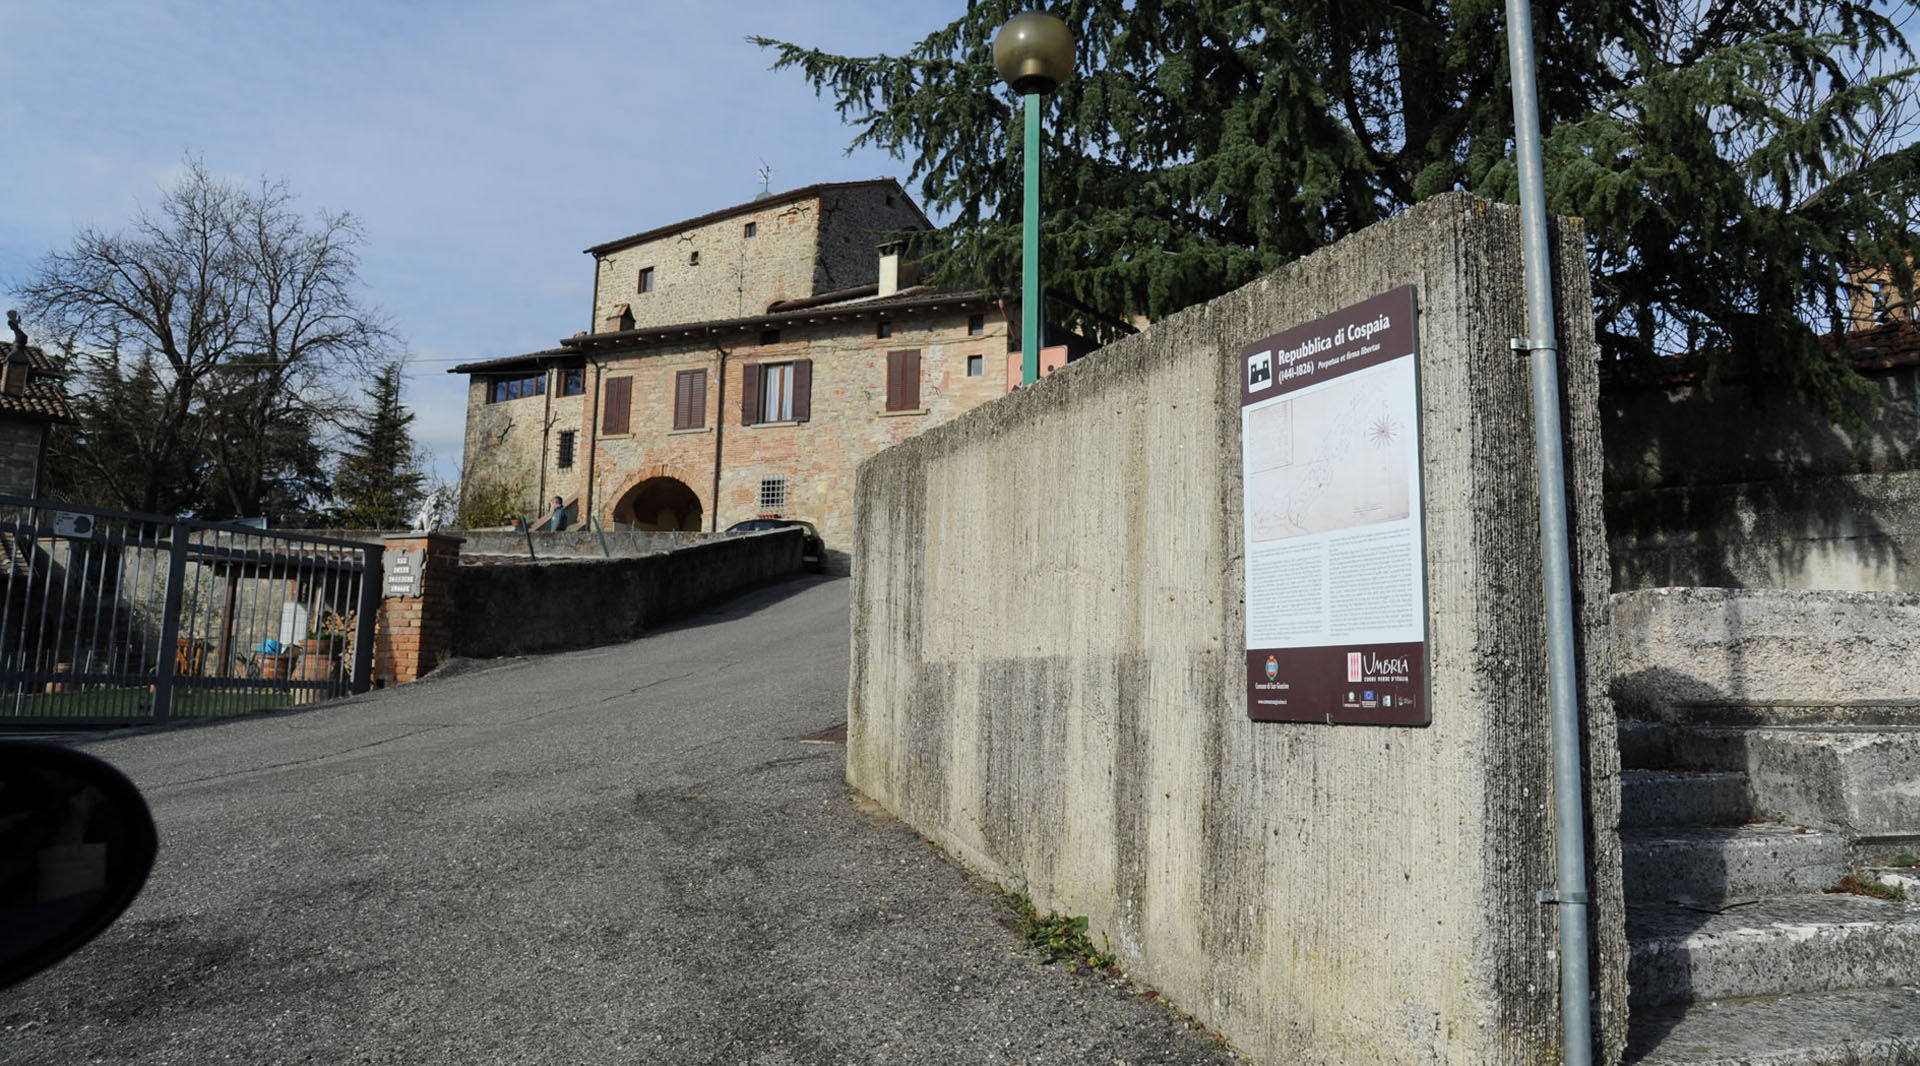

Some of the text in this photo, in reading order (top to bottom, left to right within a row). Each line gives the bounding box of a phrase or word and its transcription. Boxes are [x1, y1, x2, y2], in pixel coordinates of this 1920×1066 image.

[1278, 314, 1390, 366] Repubblica di Cospaia
[1278, 361, 1315, 385] (1441-1826)
[1360, 343, 1380, 356] libertas
